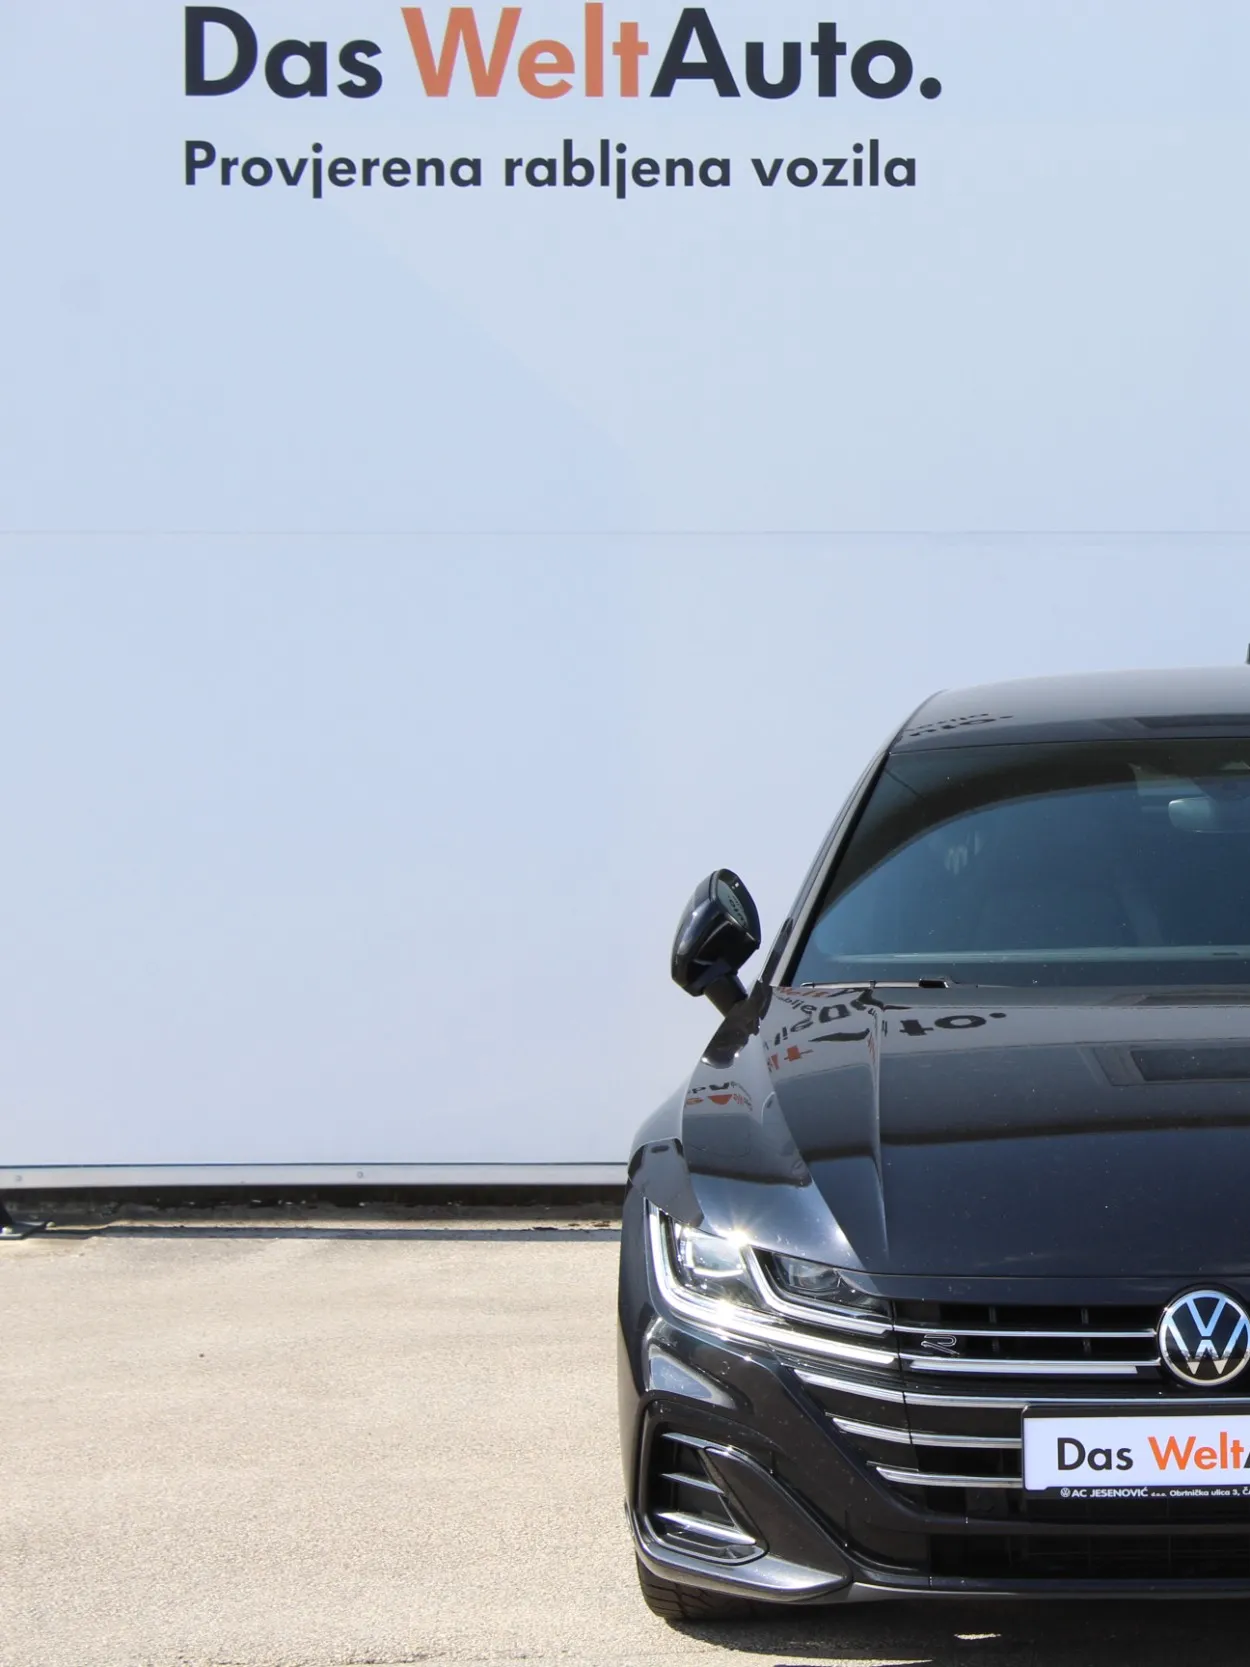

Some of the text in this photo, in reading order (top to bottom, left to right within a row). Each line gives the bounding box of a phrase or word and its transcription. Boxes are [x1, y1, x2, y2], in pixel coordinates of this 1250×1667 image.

[184, 2, 942, 100] Das WeltAuto.
[185, 138, 916, 200] Provjerena rabljena vozila
[1057, 1437, 1134, 1471] Das
[1071, 1488, 1088, 1498] AC
[1090, 1486, 1149, 1498] JESENOVIĆ
[1211, 1488, 1231, 1497] ulica
